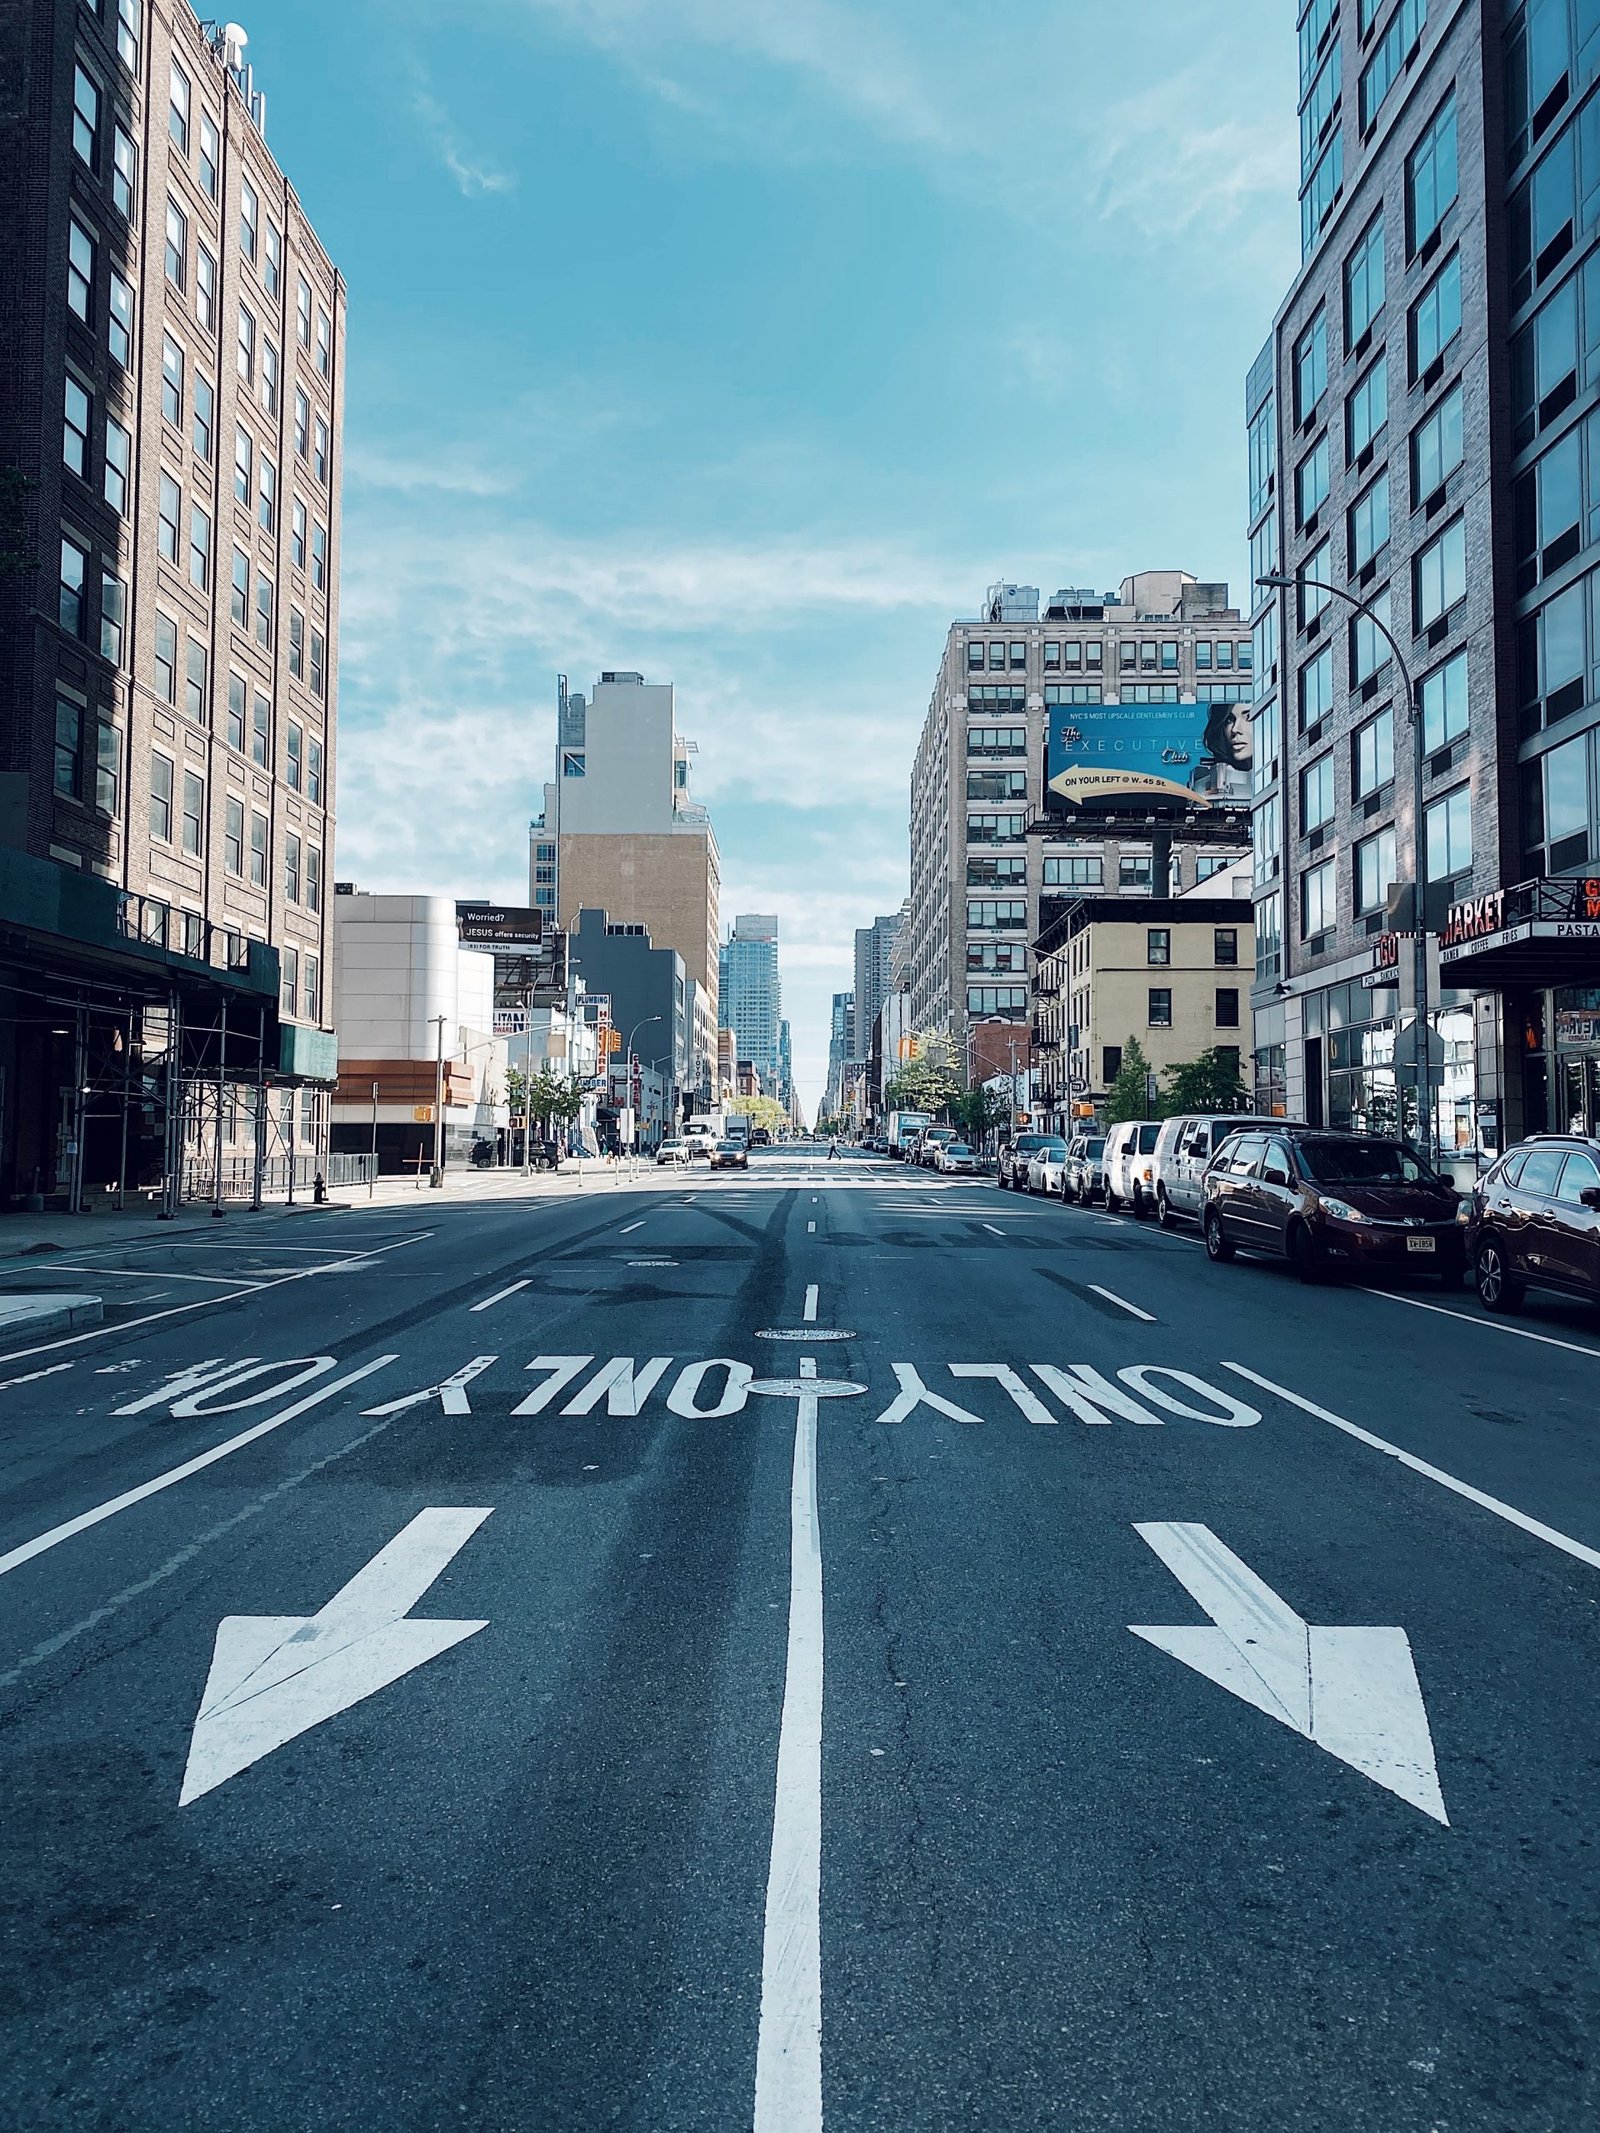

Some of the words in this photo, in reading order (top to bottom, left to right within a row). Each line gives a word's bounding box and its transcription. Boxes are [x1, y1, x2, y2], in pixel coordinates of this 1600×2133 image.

[1089, 712, 1107, 720] MOST
[1060, 726, 1081, 742] The
[1065, 740, 1201, 751] EXECUTIVE
[1161, 748, 1188, 763] Club
[1065, 778, 1077, 786] ON
[1079, 776, 1100, 784] YOUR
[467, 912, 504, 922] Worried?
[466, 928, 493, 937] JESUS
[514, 932, 539, 940] security
[1557, 925, 1599, 936] PASTA
[1471, 938, 1489, 953] COFFEE
[578, 996, 608, 1004] PLUMBING
[358, 1355, 754, 1420] ONLY
[875, 1362, 1263, 1428] ONLY
